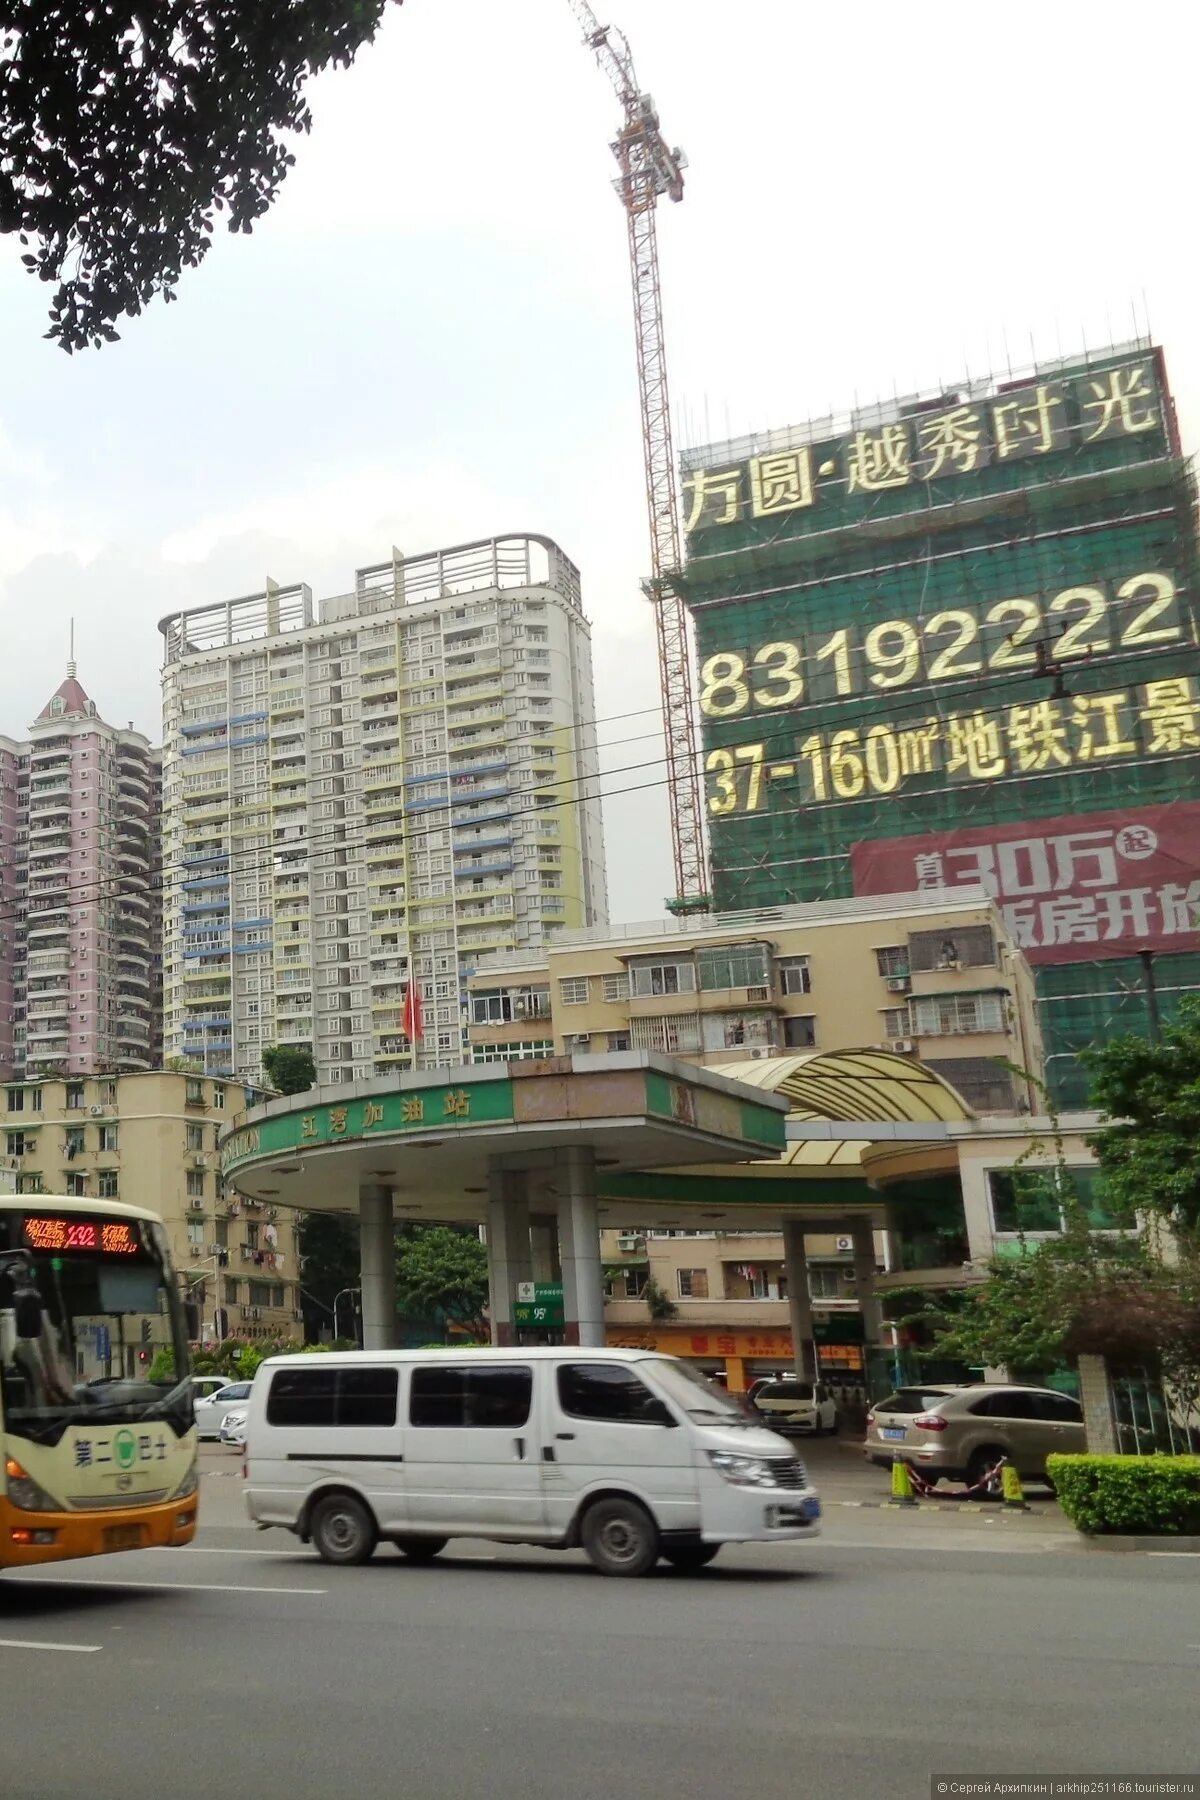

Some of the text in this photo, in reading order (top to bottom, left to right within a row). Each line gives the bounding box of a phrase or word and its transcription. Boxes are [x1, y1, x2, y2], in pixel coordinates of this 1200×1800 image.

[699, 572, 1182, 718] 83192222
[302, 1089, 471, 1138] 江湾加油站
